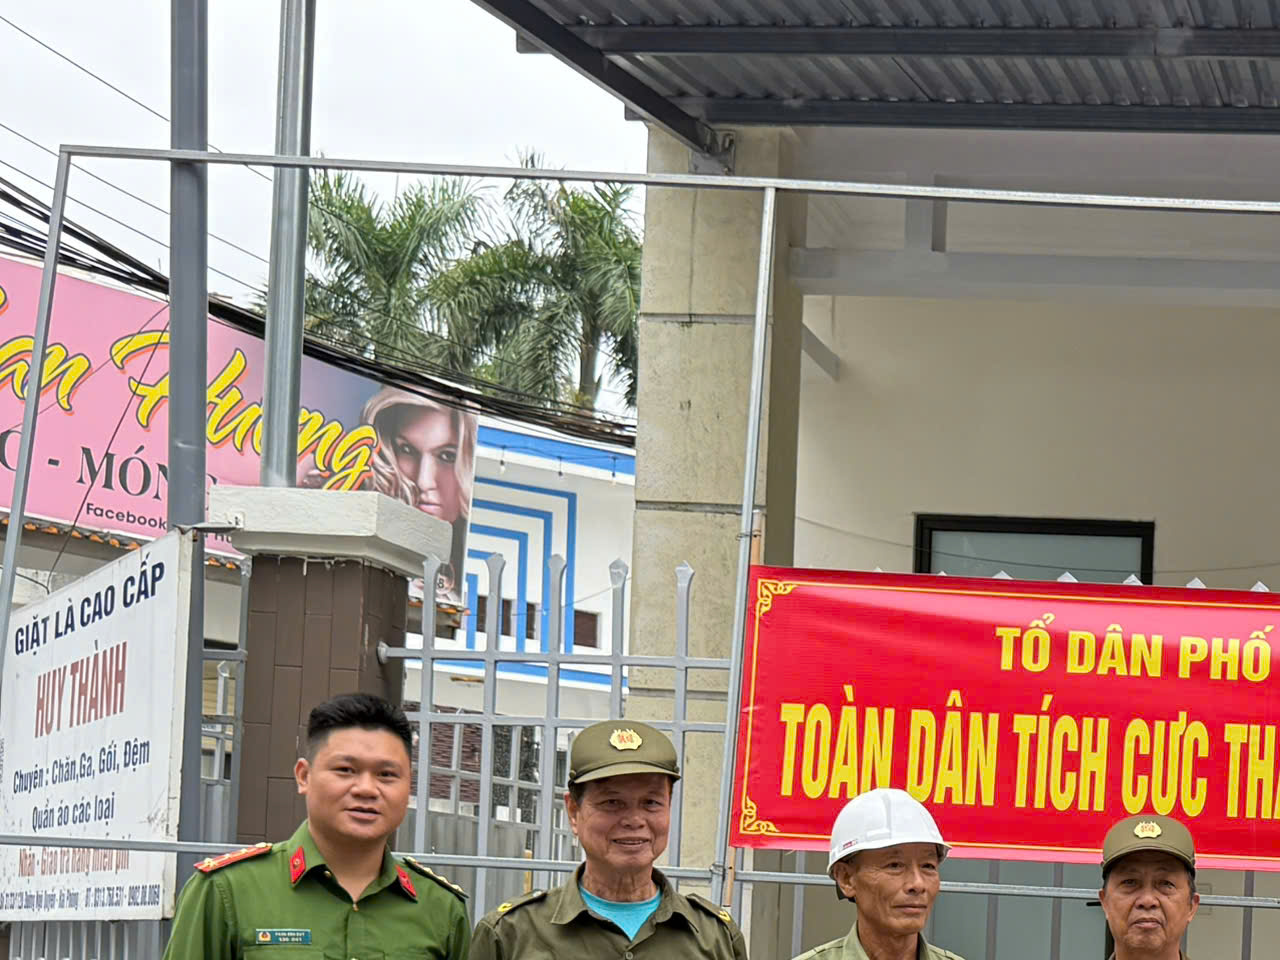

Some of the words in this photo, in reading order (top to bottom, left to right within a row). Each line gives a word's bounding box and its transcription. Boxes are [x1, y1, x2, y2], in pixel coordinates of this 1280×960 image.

[86, 502, 168, 530] Facebook
[15, 614, 50, 656] GIẶT
[54, 598, 75, 639] LÀ
[80, 585, 115, 627] CAO
[123, 552, 165, 608] CẤP
[995, 612, 1057, 672] TỔ
[1066, 623, 1163, 678] DÂN
[1178, 624, 1275, 683] PHỐ
[34, 664, 67, 738] HUY
[70, 640, 128, 728] THÀNH
[13, 764, 44, 794] Chuyên
[124, 737, 150, 771] Đệm
[780, 684, 895, 801] TOÀN
[908, 689, 998, 807] DÂN
[1013, 694, 1110, 812] TÍCH
[57, 799, 69, 827] áo
[72, 796, 91, 823] các
[94, 792, 115, 826] loại
